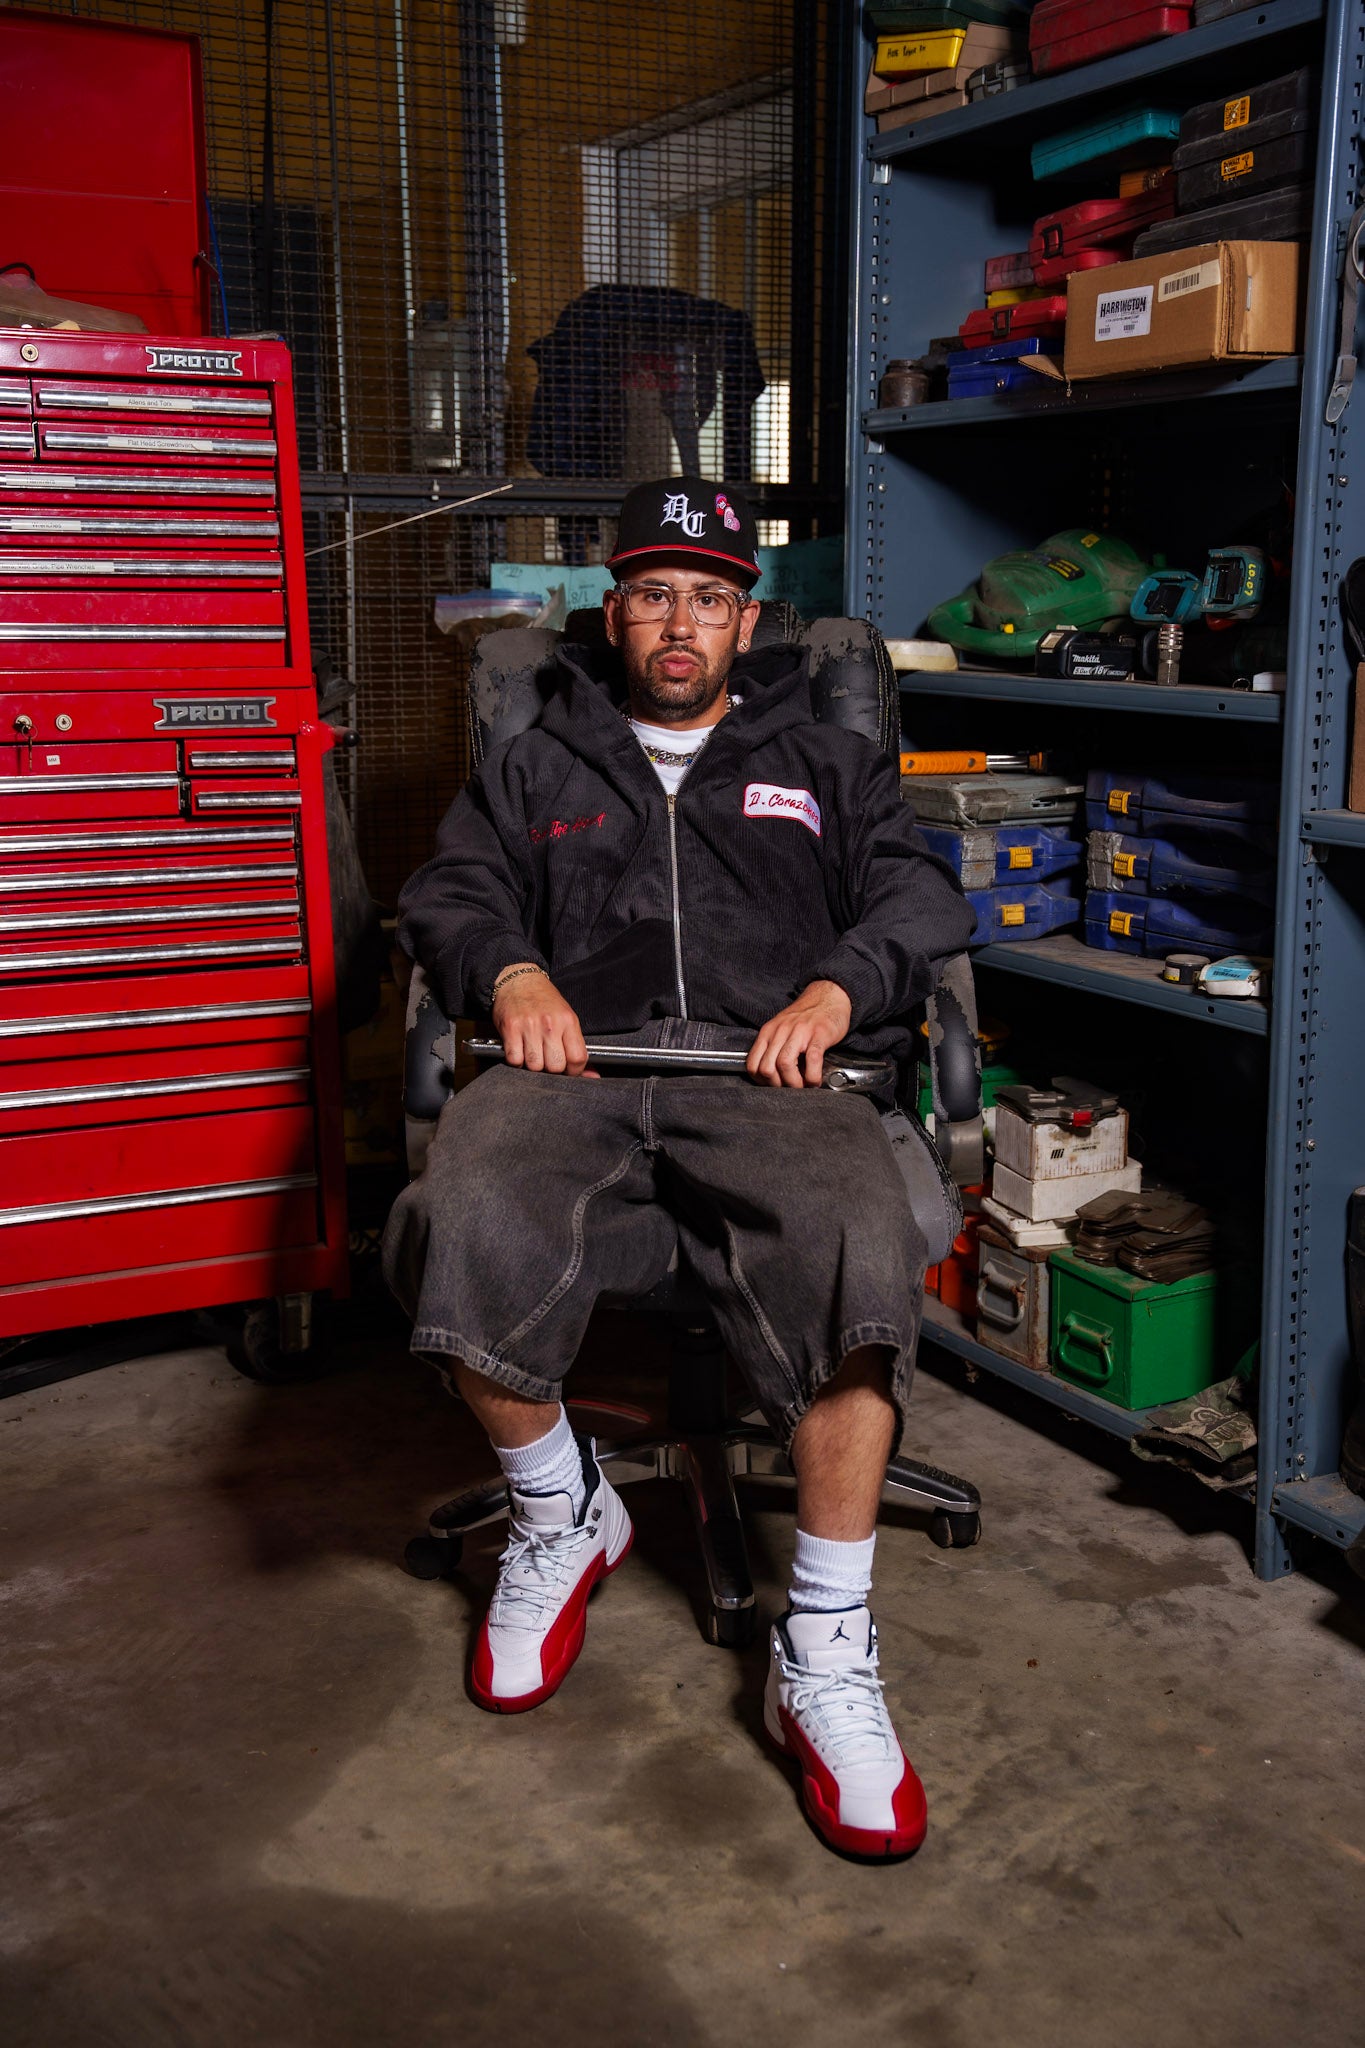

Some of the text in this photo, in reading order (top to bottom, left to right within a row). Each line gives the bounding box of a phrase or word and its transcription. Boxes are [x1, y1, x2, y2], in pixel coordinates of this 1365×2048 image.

[1100, 297, 1147, 318] HARRINGTON
[160, 354, 229, 369] PROTO
[147, 399, 158, 407] and
[127, 439, 139, 447] Flat
[171, 705, 260, 722] PROTO
[748, 791, 765, 807] D.
[549, 820, 569, 838] The
